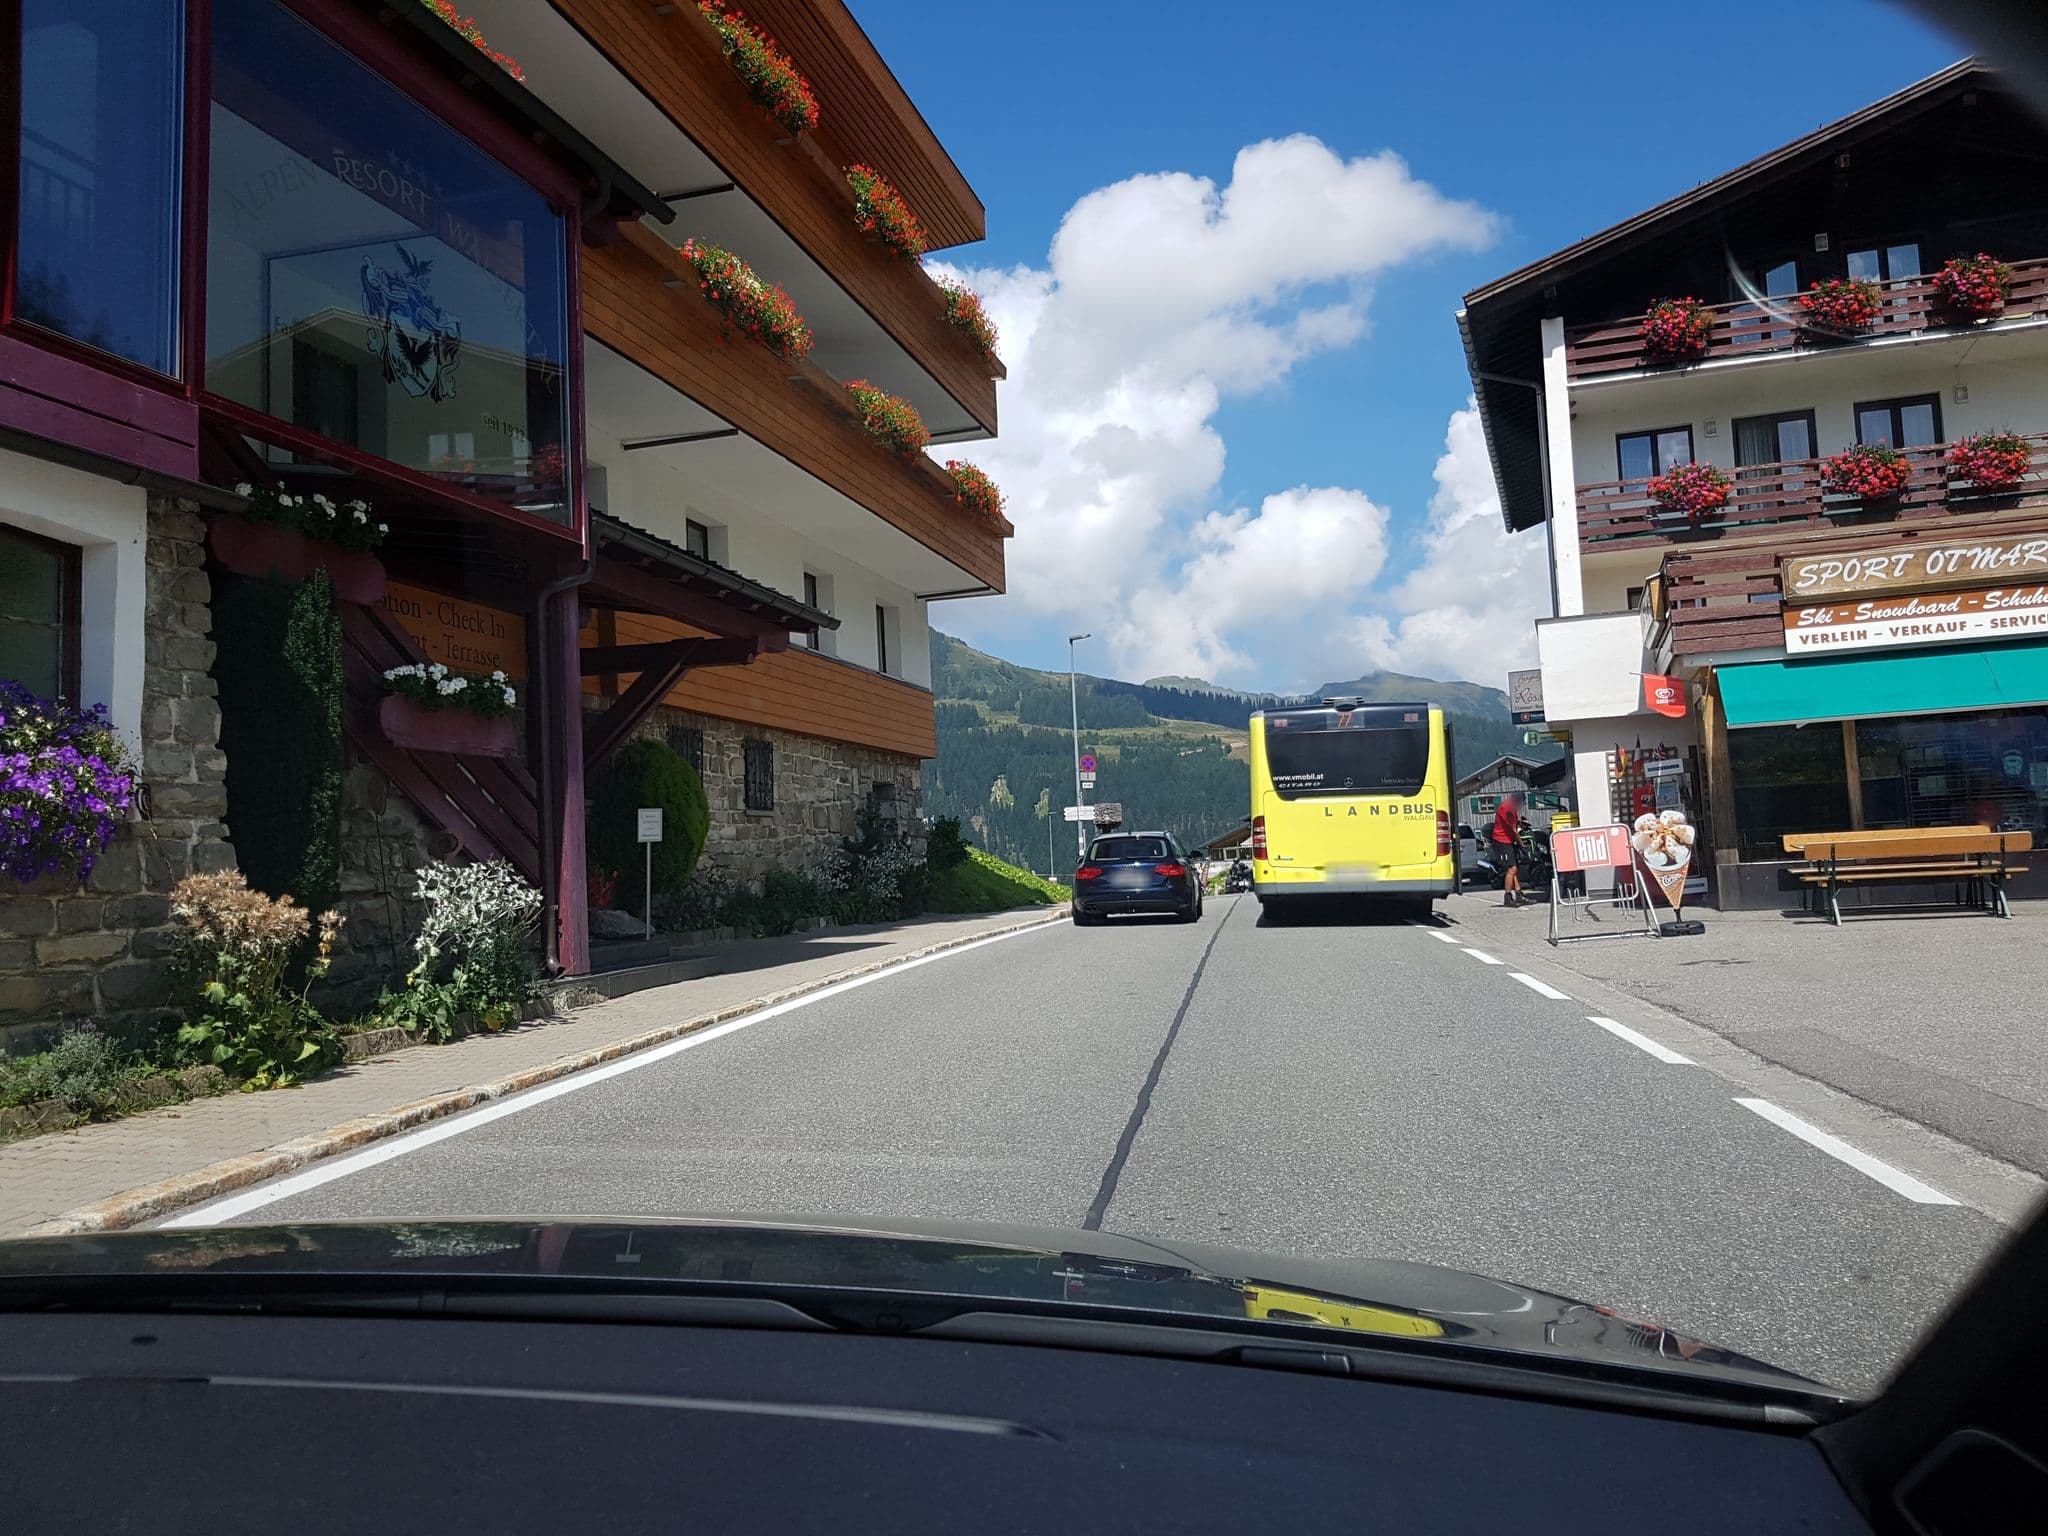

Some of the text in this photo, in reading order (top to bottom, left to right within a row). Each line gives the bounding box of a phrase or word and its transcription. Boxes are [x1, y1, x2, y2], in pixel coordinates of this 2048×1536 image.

[334, 156, 433, 217] RESORT
[1795, 540, 2048, 589] SPORT OTMAR
[437, 600, 486, 635] Check
[489, 614, 505, 639] In
[1797, 607, 1833, 627] Ski
[1854, 596, 1962, 622] Snowboard
[1799, 629, 1868, 646] VERLEIH
[1889, 620, 1968, 638] VERKAUF
[1990, 613, 2048, 629] SERVIC
[442, 633, 501, 669] Terrasse
[1336, 711, 1353, 729] 77
[1528, 732, 1538, 745] H
[1272, 773, 1325, 782] www.vmobil.at
[1403, 814, 1434, 822] WALGAU
[1576, 834, 1608, 863] Bild
